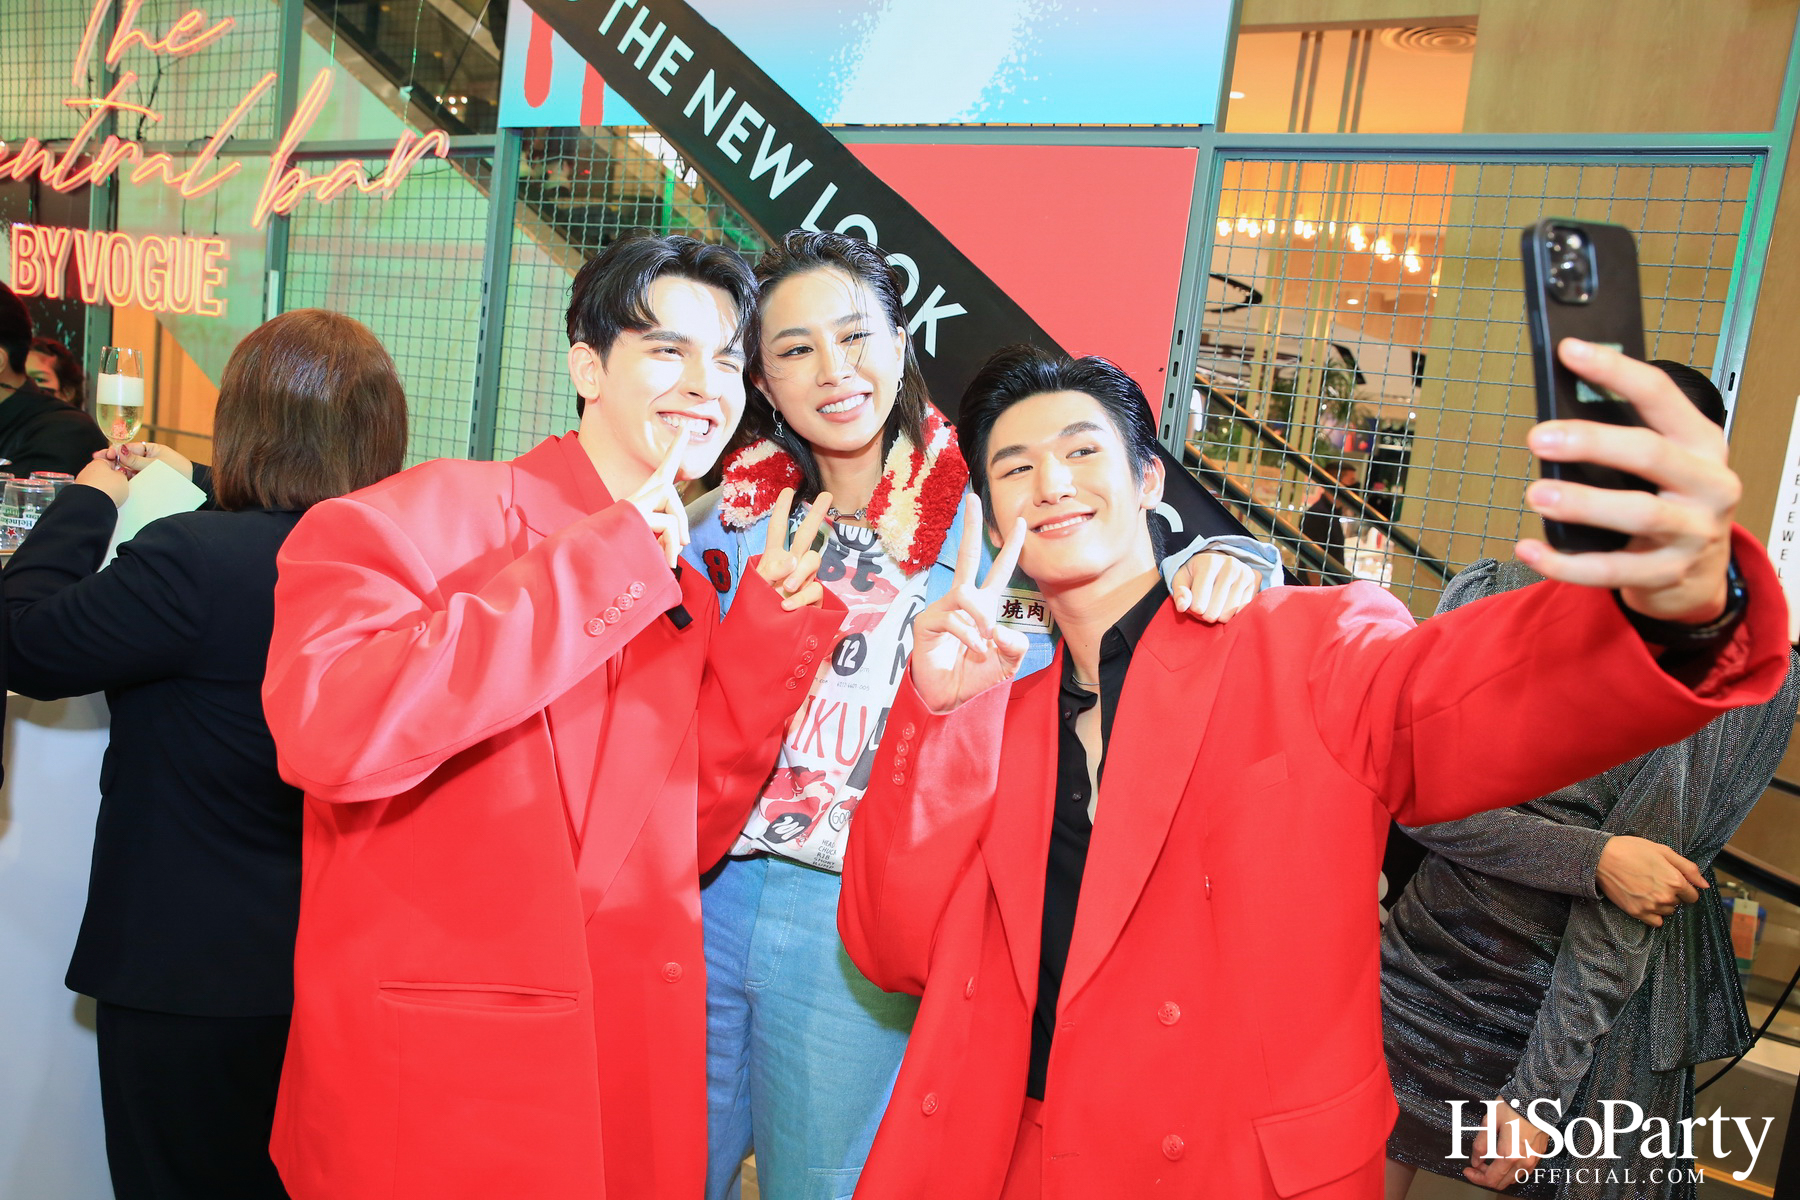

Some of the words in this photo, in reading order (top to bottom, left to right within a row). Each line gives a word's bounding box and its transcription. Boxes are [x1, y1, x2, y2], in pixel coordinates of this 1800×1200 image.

[598, 0, 695, 97] THE
[683, 68, 813, 200] NEW
[252, 68, 450, 229] bar
[12, 223, 73, 299] BY
[74, 228, 230, 317] VOGUE
[702, 549, 732, 593] 8
[1001, 599, 1045, 622] 焼肉
[837, 639, 860, 669] 12
